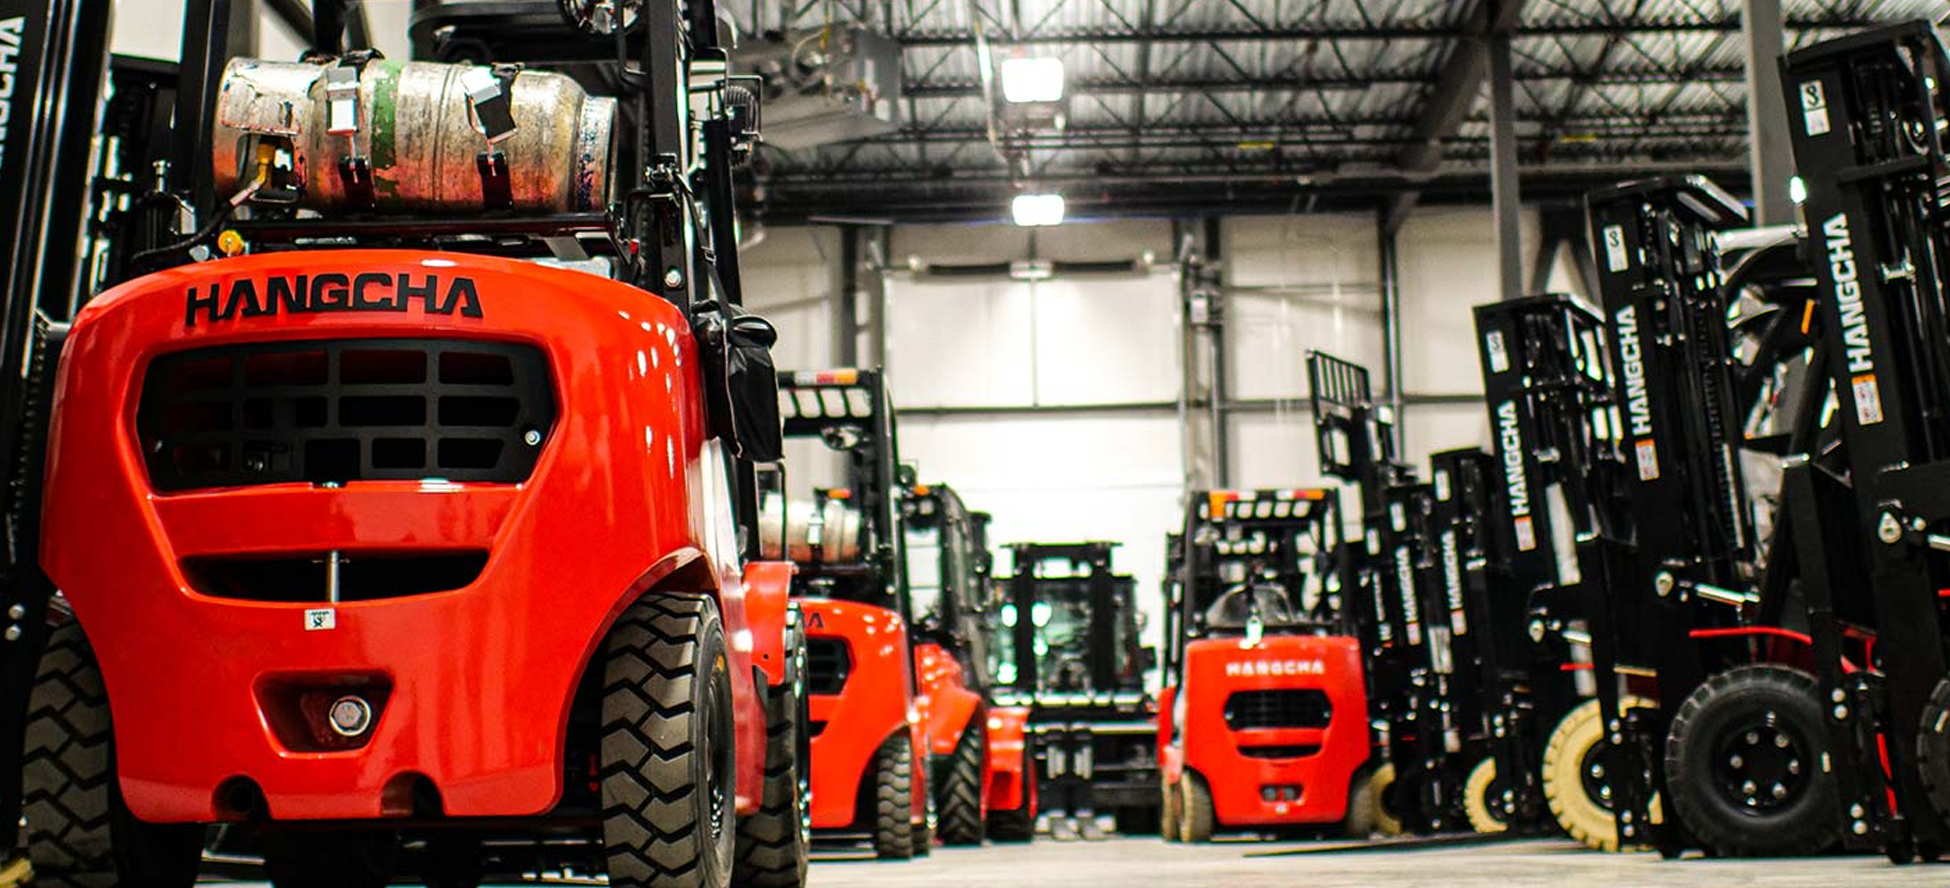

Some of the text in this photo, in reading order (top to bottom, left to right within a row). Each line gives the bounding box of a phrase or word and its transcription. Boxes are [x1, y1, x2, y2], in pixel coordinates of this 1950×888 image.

[185, 272, 484, 327] HANGCHA
[1822, 212, 1874, 373] HANGCHA
[1616, 304, 1652, 436] HANGCHA
[1497, 400, 1531, 517] HANGCHA
[1226, 660, 1325, 677] HANGCHA
